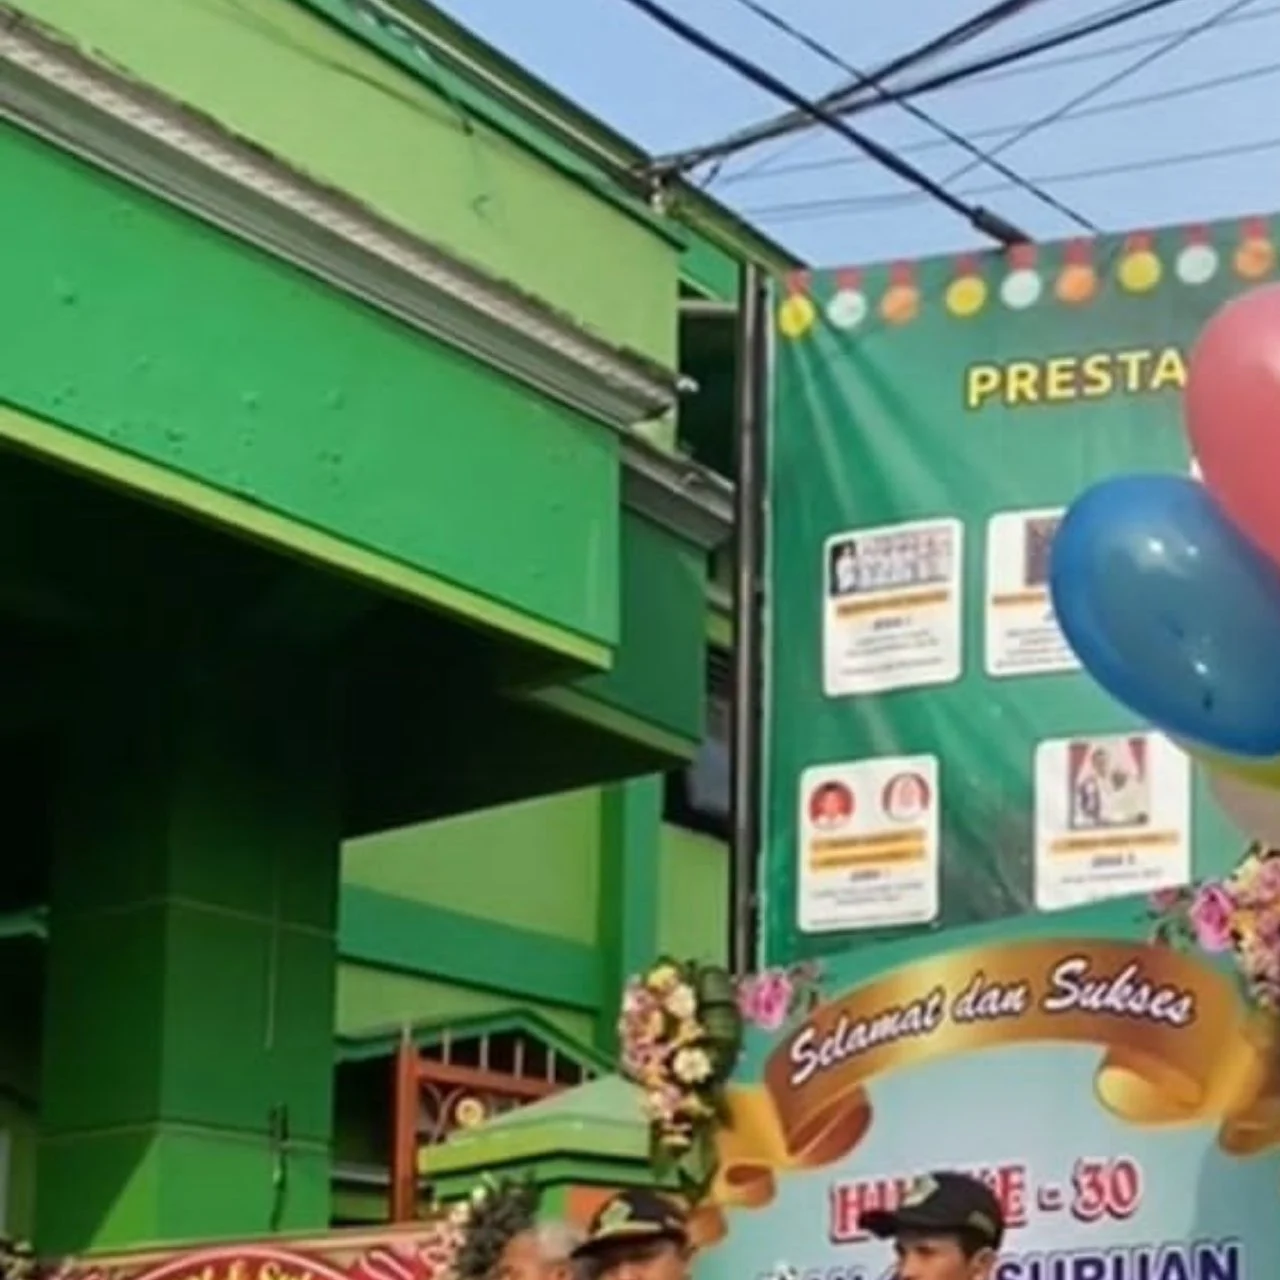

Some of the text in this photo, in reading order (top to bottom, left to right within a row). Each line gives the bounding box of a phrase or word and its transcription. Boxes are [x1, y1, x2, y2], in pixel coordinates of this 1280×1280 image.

[968, 346, 1187, 407] PRESTA
[789, 957, 1194, 1085] Selamat dan Sukses
[1073, 1158, 1141, 1220] 30
